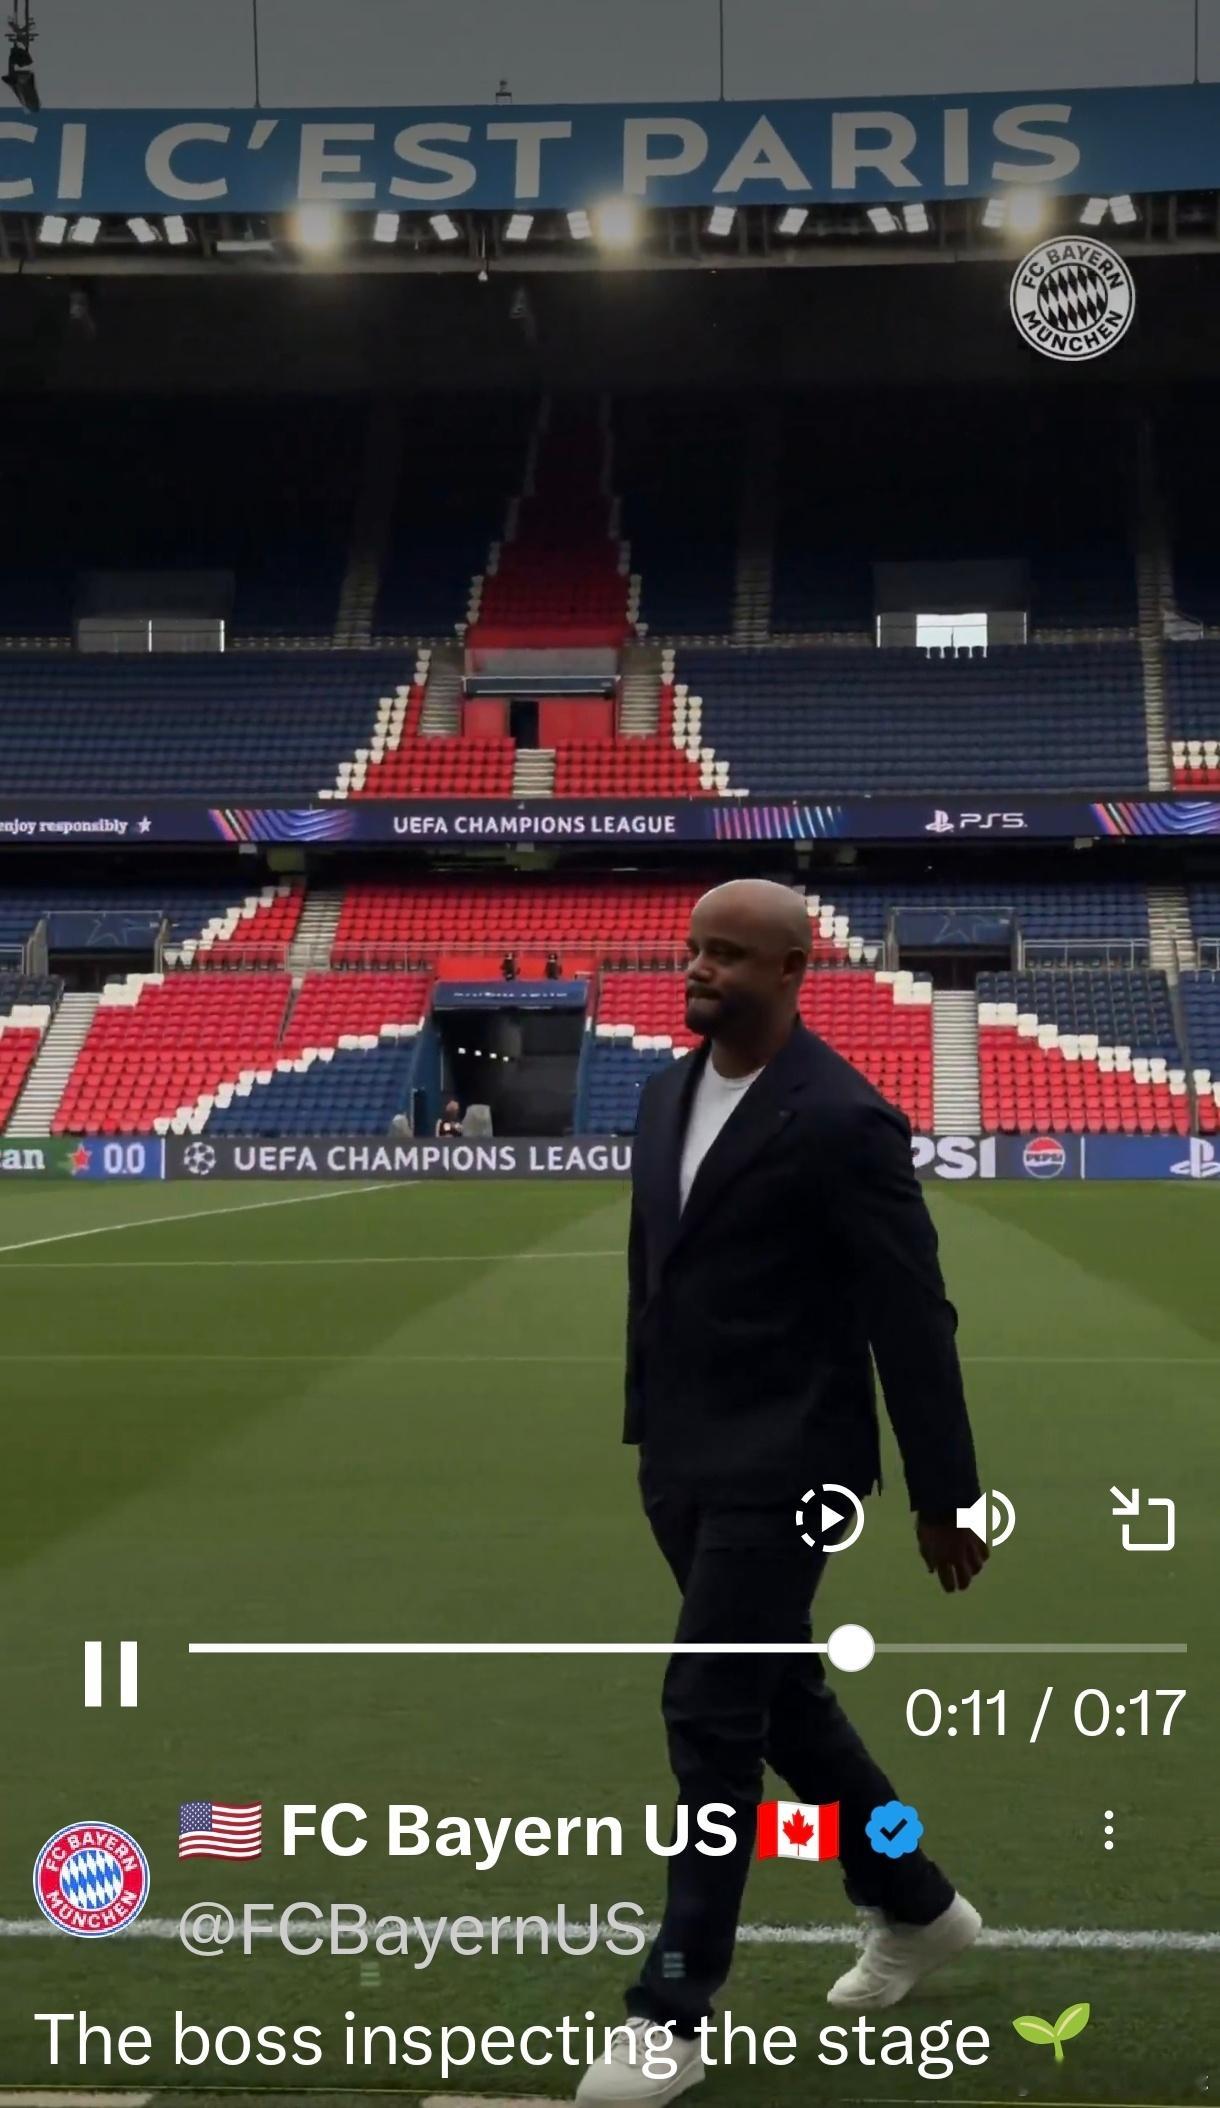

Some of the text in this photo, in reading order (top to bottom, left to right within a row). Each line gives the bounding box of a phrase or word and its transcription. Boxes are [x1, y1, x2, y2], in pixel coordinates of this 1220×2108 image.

[622, 103, 1082, 196] PARIS
[39, 817, 129, 835] responsibly
[393, 815, 676, 834] UEFA CHAMPIONS LEAGUE
[959, 812, 1025, 829] PS5
[0, 1148, 46, 1170] an
[233, 1145, 633, 1172] UEFA CHAMPIONS LEAGU
